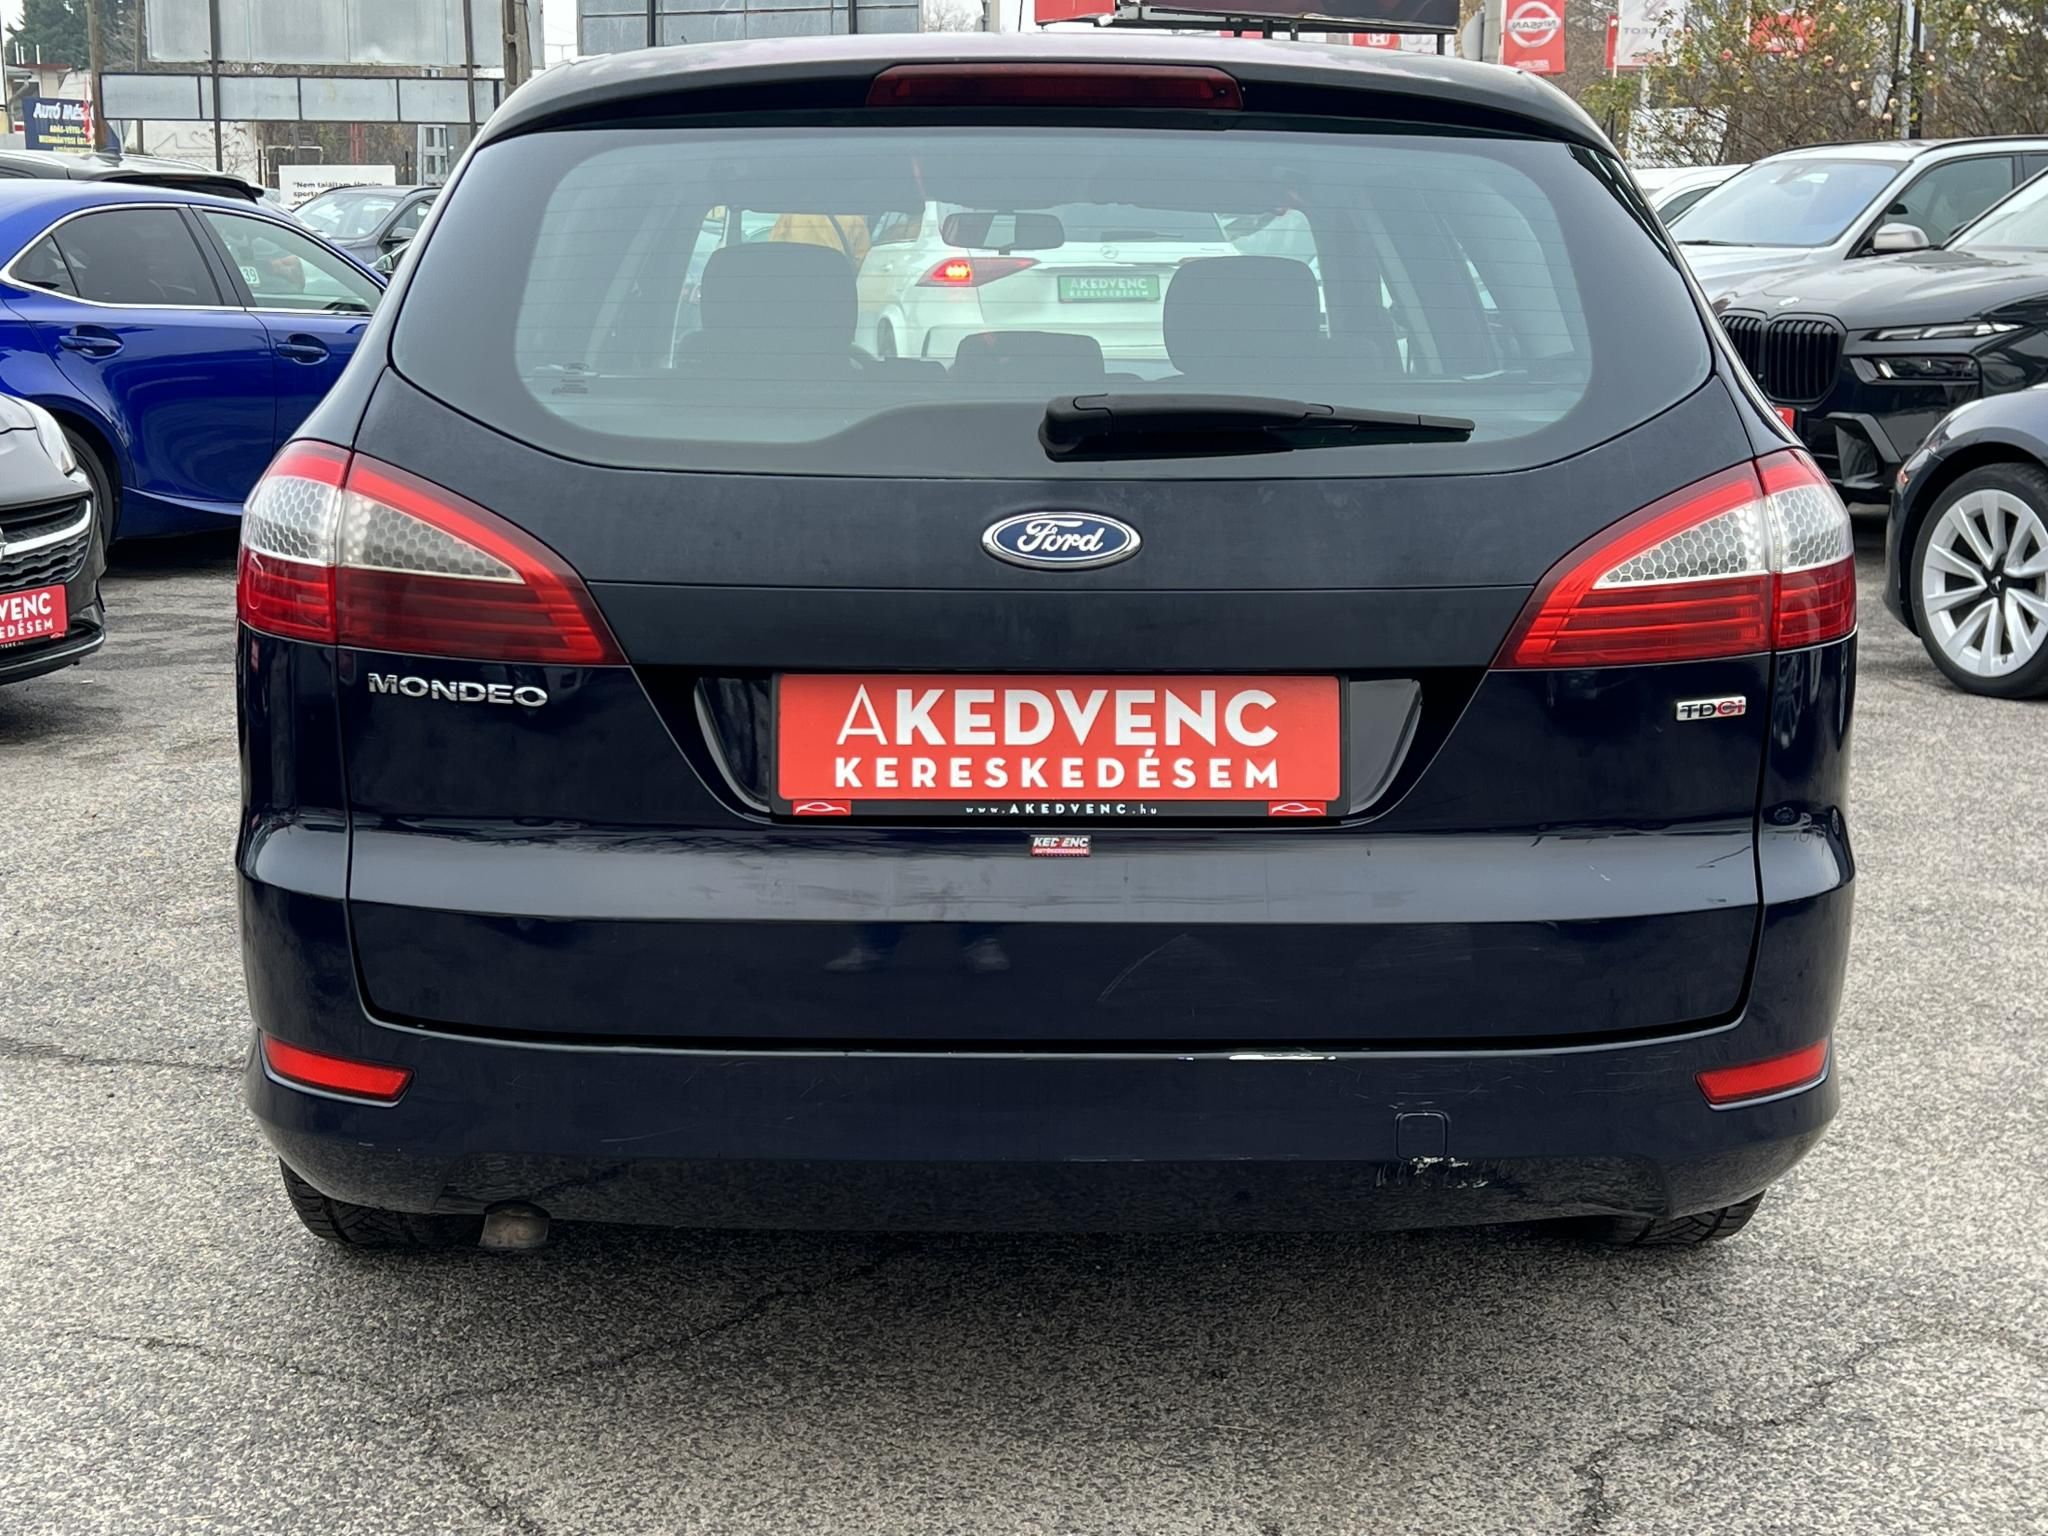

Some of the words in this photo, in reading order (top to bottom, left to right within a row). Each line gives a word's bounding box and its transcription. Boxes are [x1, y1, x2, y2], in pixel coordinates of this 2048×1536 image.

[1016, 518, 1105, 552] Ford
[368, 673, 548, 707] MONDEO
[1680, 699, 1744, 719] TDCi
[834, 749, 1279, 789] KERESKEDÉSEM
